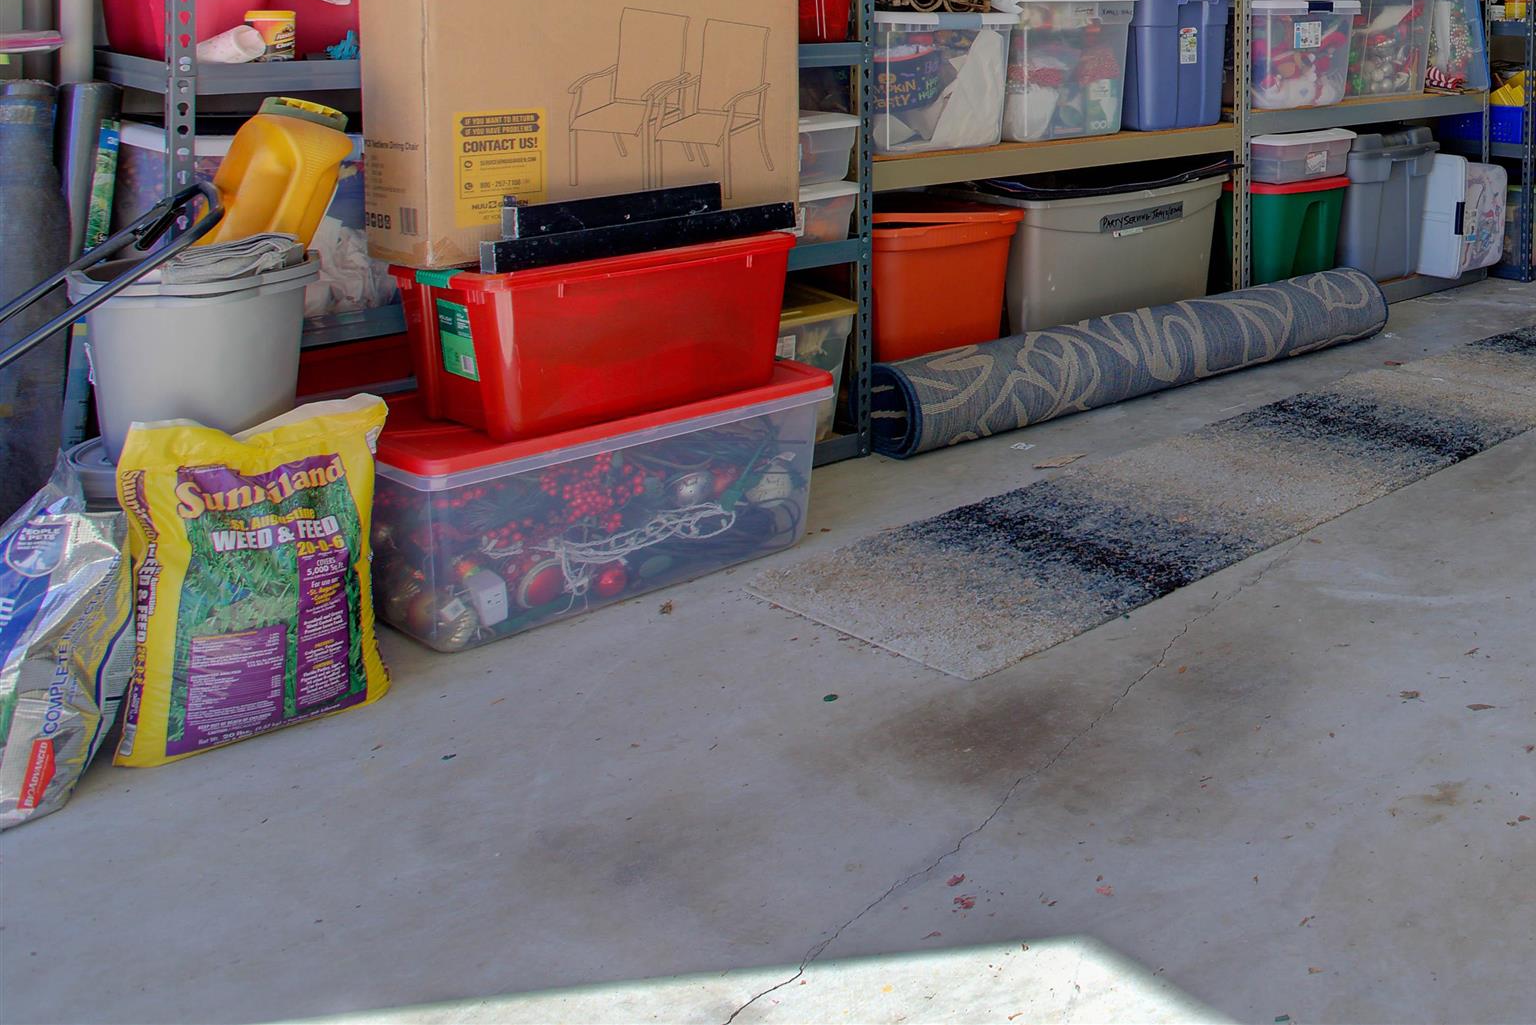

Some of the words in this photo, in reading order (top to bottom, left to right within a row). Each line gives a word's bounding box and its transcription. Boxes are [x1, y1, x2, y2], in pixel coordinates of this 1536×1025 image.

[463, 138, 516, 153] CONTACT
[519, 137, 538, 149] US!
[1103, 216, 1124, 229] PARTY
[211, 529, 273, 552] WEED
[277, 526, 296, 544] &
[296, 516, 340, 539] FEED
[296, 535, 346, 557] 20-0-6
[307, 565, 329, 576] 5,000
[43, 645, 71, 735] COMPLETE
